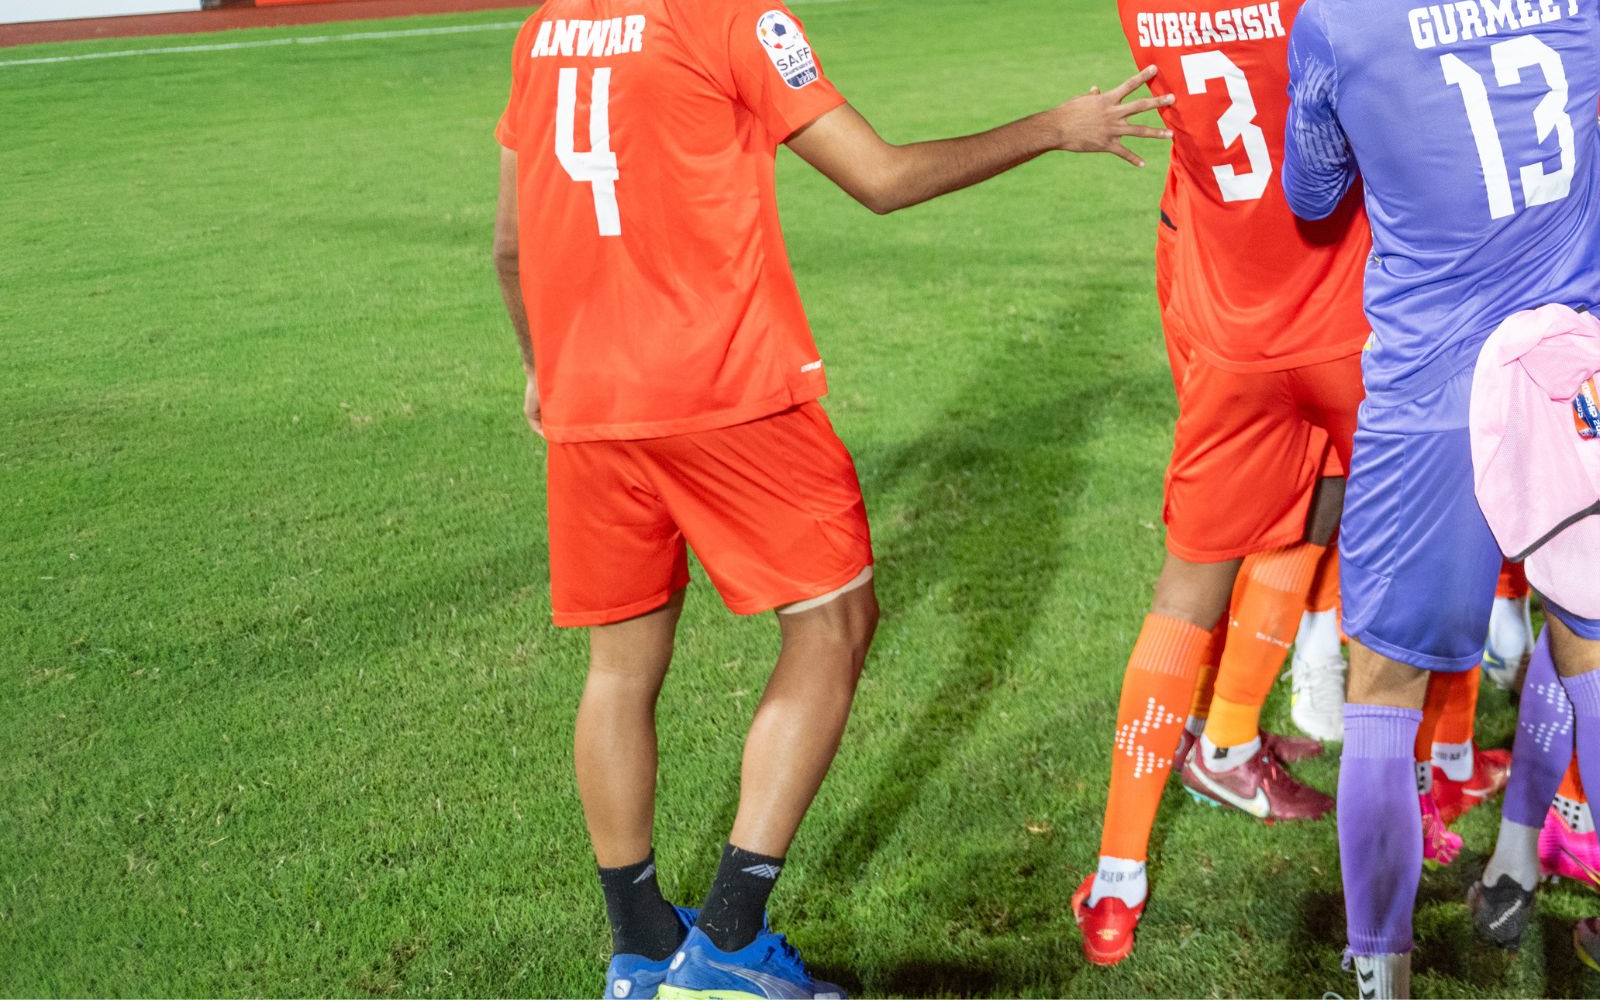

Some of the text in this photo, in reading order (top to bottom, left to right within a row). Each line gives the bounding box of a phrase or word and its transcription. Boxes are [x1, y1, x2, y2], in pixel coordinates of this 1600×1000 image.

[531, 15, 646, 58] ANWAR
[776, 47, 810, 72] SAFF
[555, 67, 622, 236] 4
[1180, 50, 1273, 203] 3
[1439, 34, 1576, 221] 13
